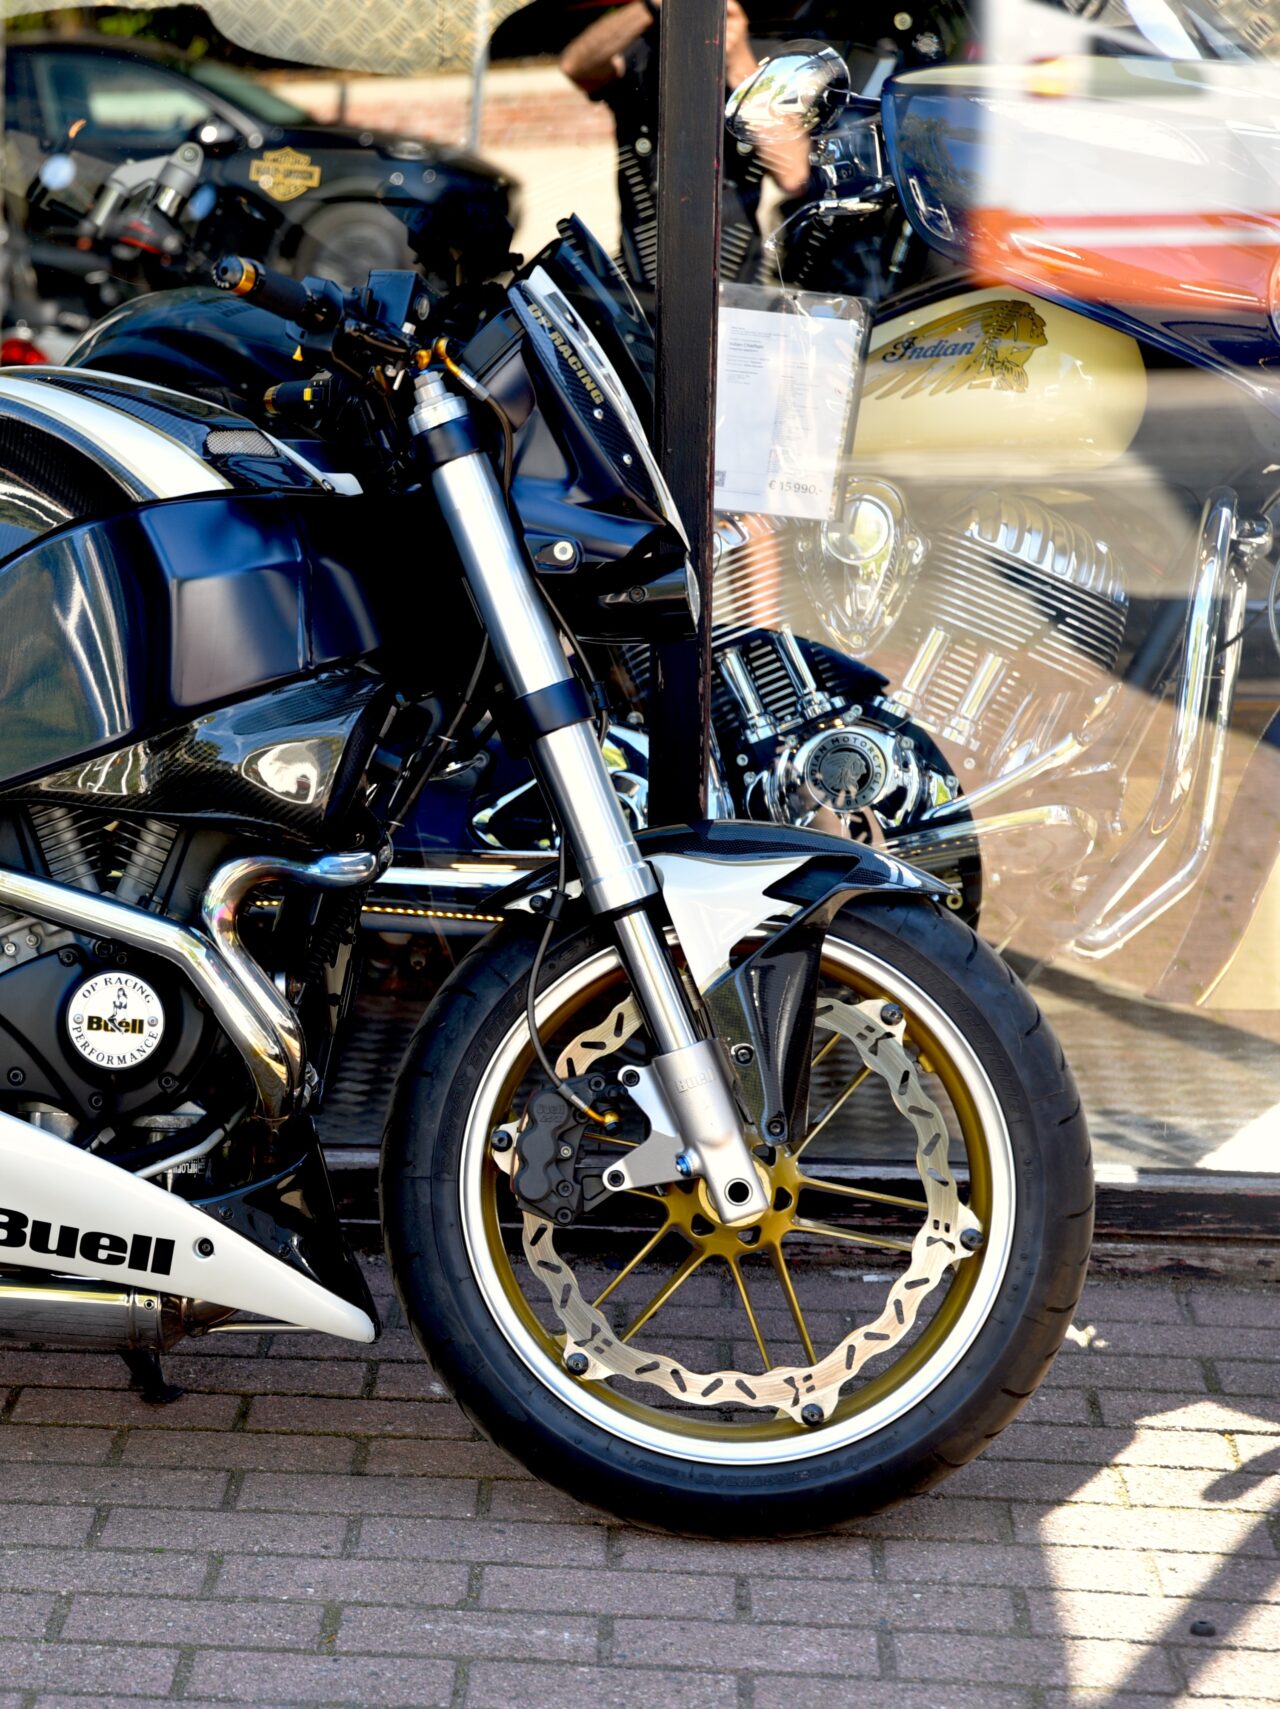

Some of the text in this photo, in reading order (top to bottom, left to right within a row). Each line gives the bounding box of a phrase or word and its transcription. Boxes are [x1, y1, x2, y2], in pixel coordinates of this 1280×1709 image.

[881, 335, 977, 363] Indian
[549, 331, 605, 405] RACING
[82, 976, 154, 1004] OP RACING
[86, 1015, 145, 1035] Buell
[72, 1025, 159, 1066] PERFORMANCE
